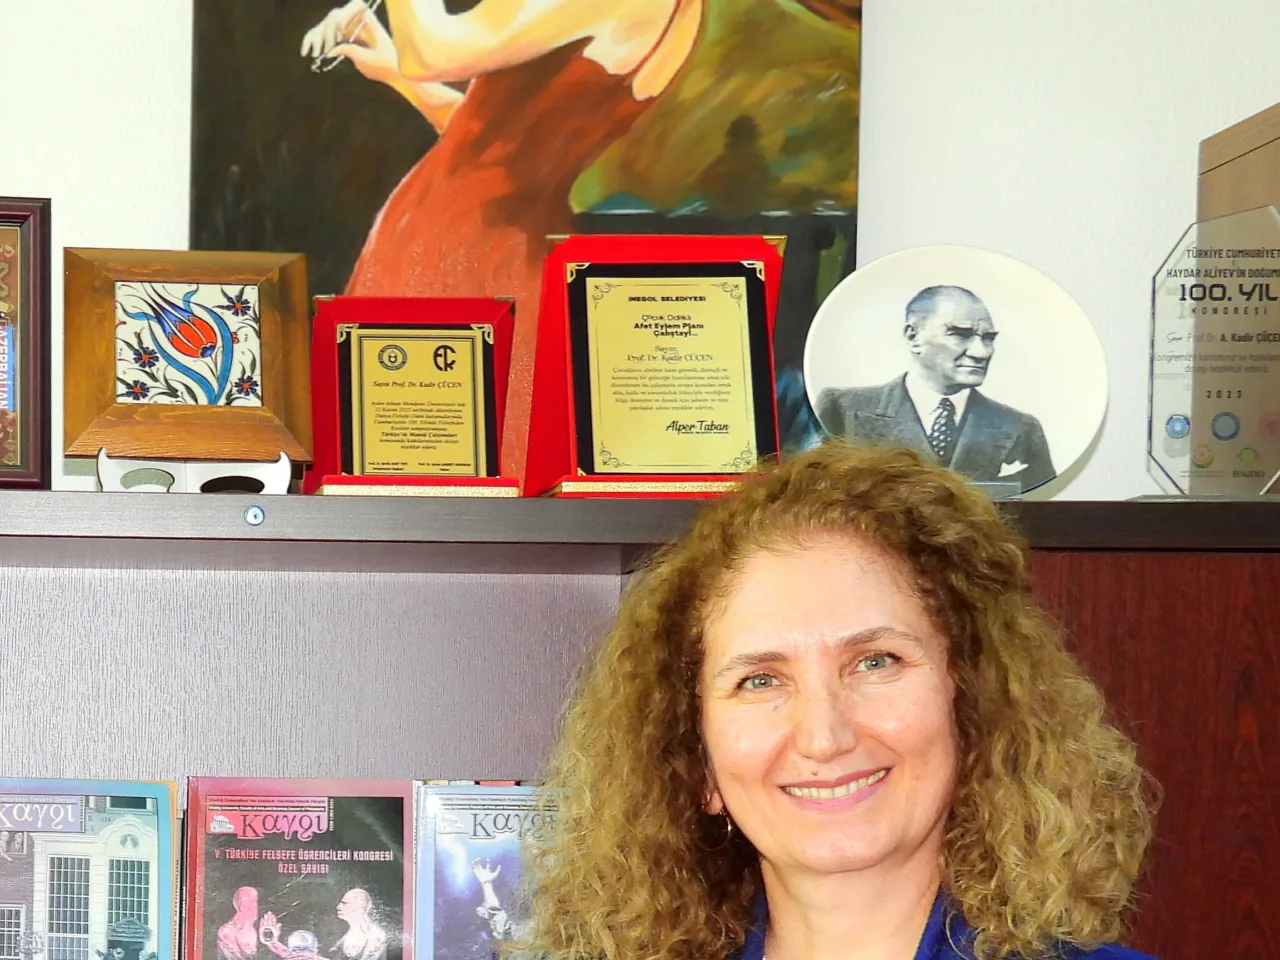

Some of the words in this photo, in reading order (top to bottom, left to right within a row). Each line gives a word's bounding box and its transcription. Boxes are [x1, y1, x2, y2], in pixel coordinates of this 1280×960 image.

[1166, 268, 1200, 278] HAYDAR
[1179, 283, 1233, 302] 100.
[665, 420, 695, 435] Alper
[696, 420, 729, 431] Taban
[225, 848, 259, 860] TÜRKİYE
[262, 850, 296, 860] FELSEFE
[353, 849, 393, 861] KONGRESİ
[278, 862, 298, 874] ÖZEL
[301, 863, 329, 874] SAYISI
